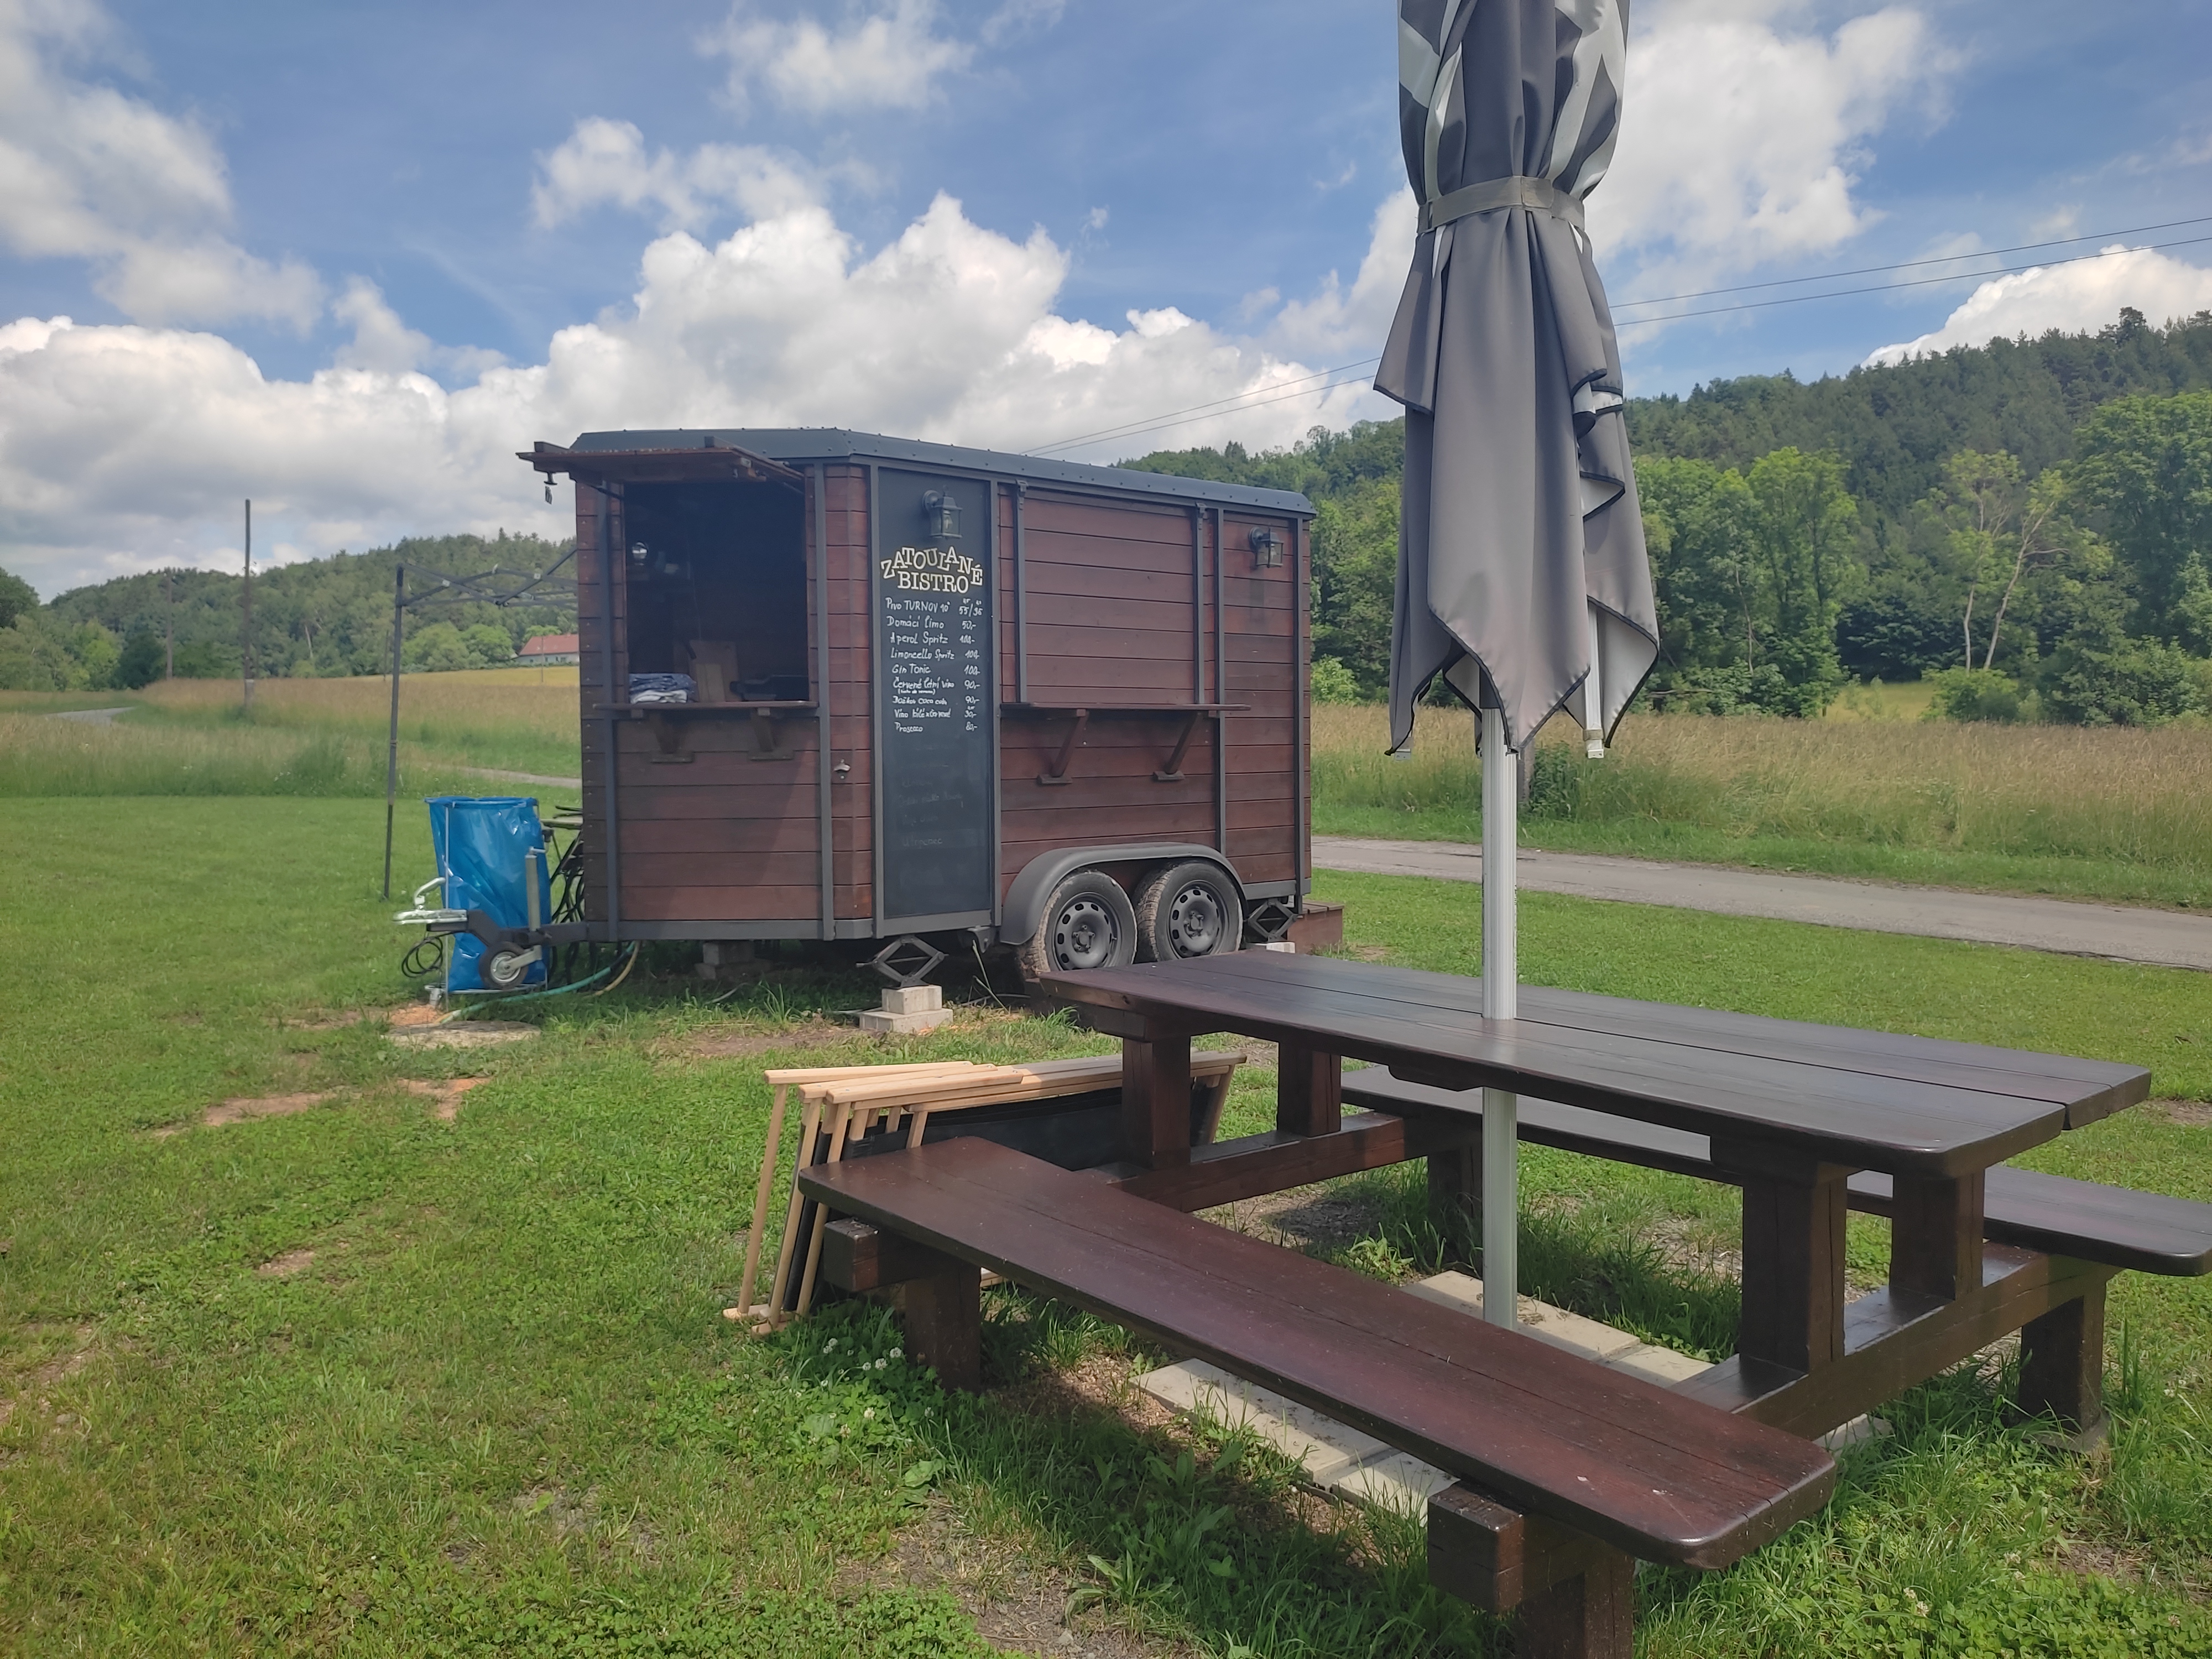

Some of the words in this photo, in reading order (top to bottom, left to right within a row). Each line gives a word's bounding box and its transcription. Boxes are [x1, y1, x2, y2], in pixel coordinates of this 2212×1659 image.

[880, 546, 983, 586] ZATOULANÉ
[897, 571, 969, 593] BISTRO
[885, 597, 902, 611] Pivo
[904, 600, 938, 613] TURNOV
[922, 631, 948, 646] Spritz
[890, 647, 932, 659] Limoncello
[935, 649, 955, 661] Spritz
[892, 664, 907, 674] Gin
[909, 664, 931, 674] Tonic
[894, 722, 924, 733] Prosecco
